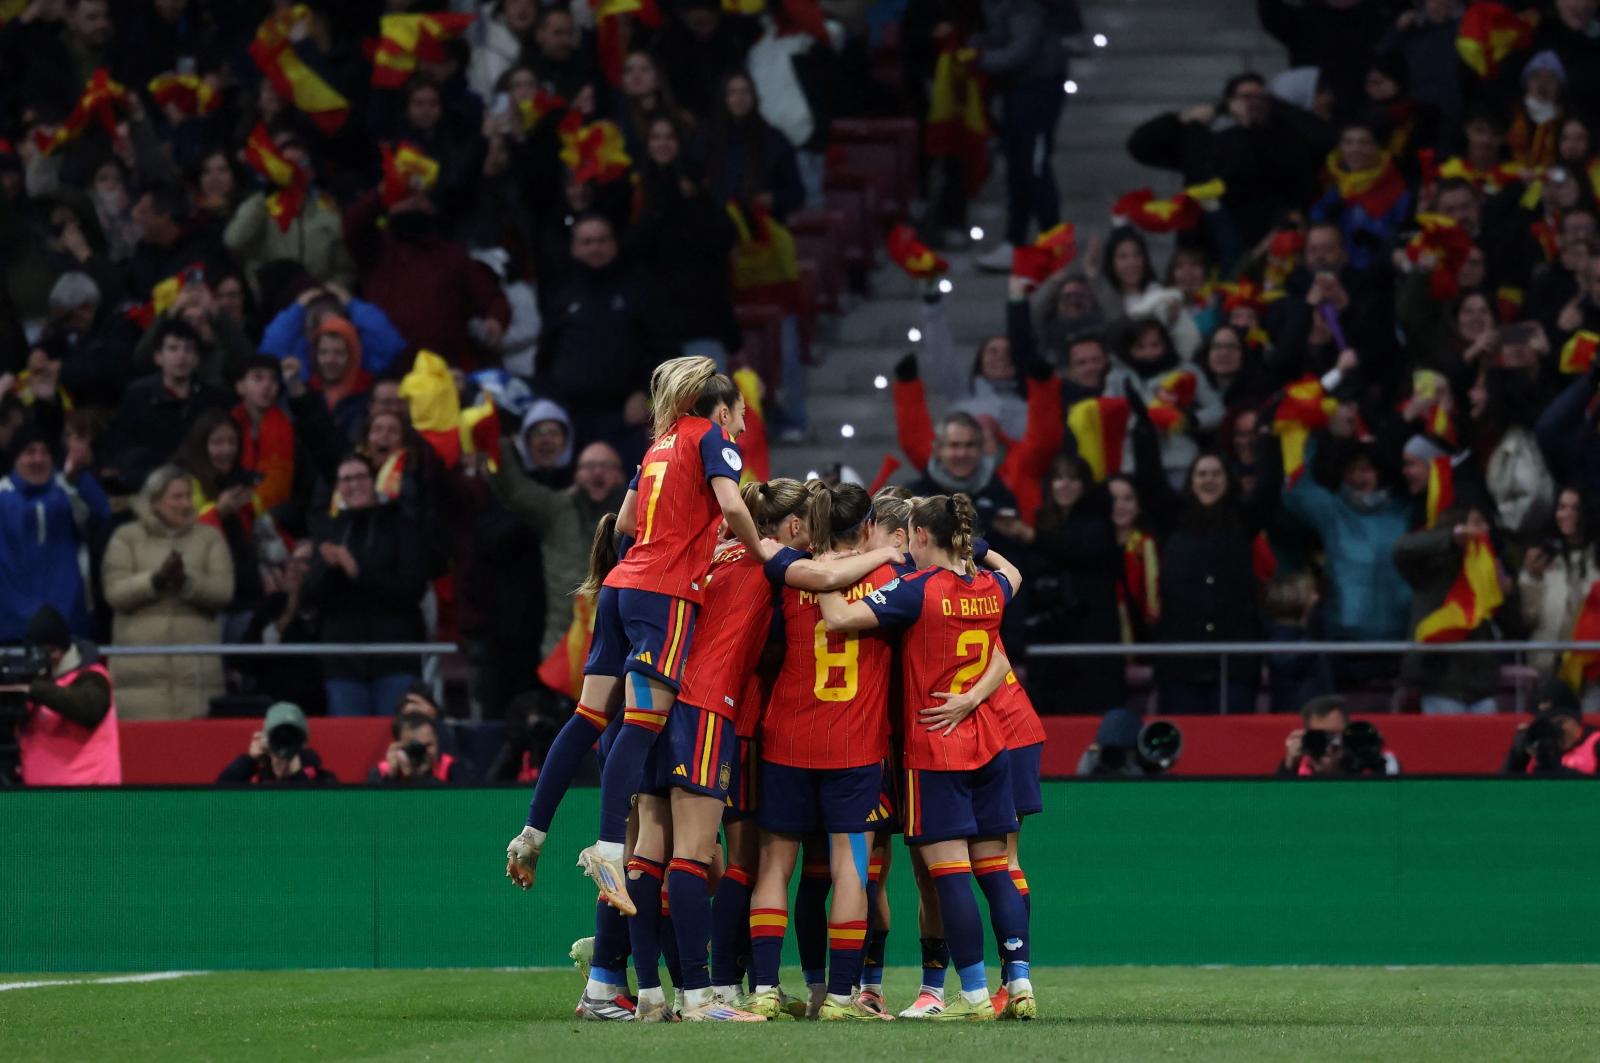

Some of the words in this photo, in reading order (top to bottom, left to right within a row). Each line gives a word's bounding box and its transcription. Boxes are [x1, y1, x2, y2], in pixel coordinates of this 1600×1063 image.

[643, 461, 669, 545] 7
[960, 596, 1000, 616] BATLLE
[813, 618, 859, 702] 8
[949, 629, 990, 695] 2
